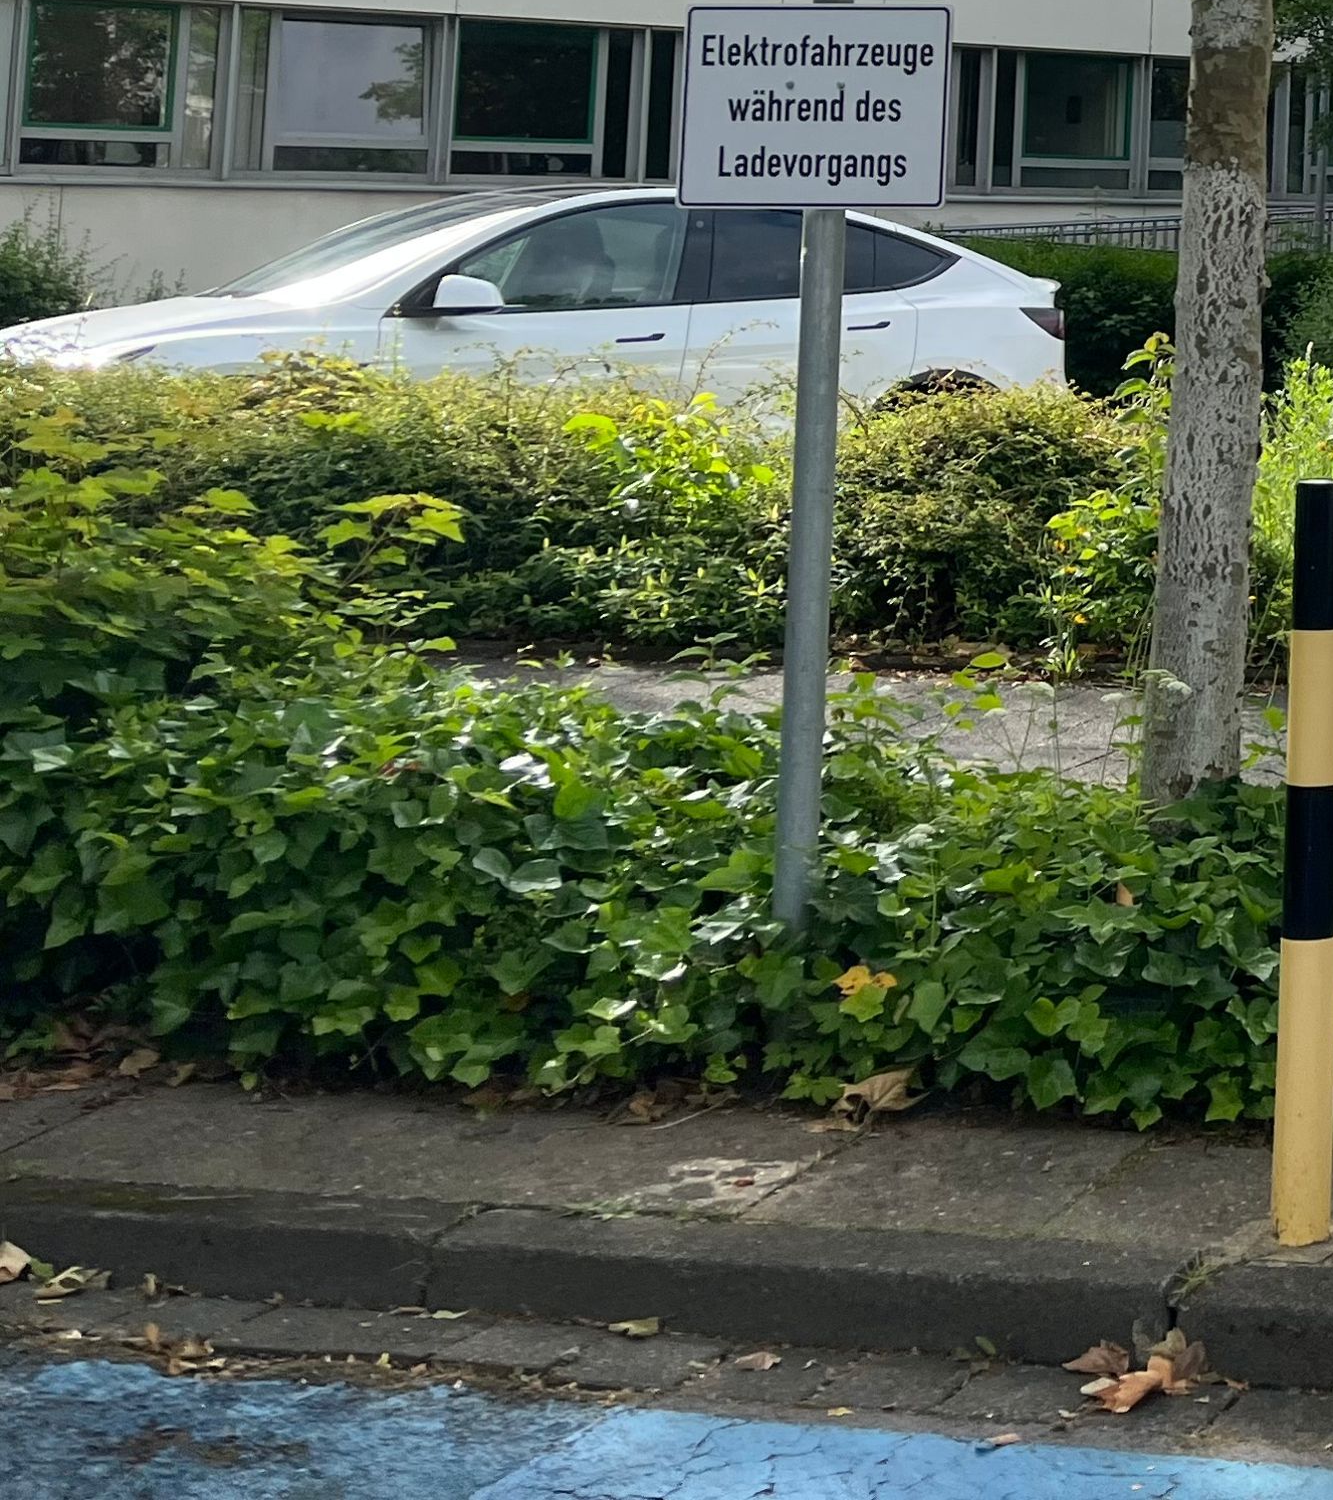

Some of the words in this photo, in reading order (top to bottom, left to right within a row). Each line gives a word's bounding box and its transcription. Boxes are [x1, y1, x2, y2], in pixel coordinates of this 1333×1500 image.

[701, 34, 934, 76] Elektrofahrzeuge
[728, 90, 844, 122] während
[856, 90, 902, 122] des
[718, 145, 907, 186] Ladevorgangs
